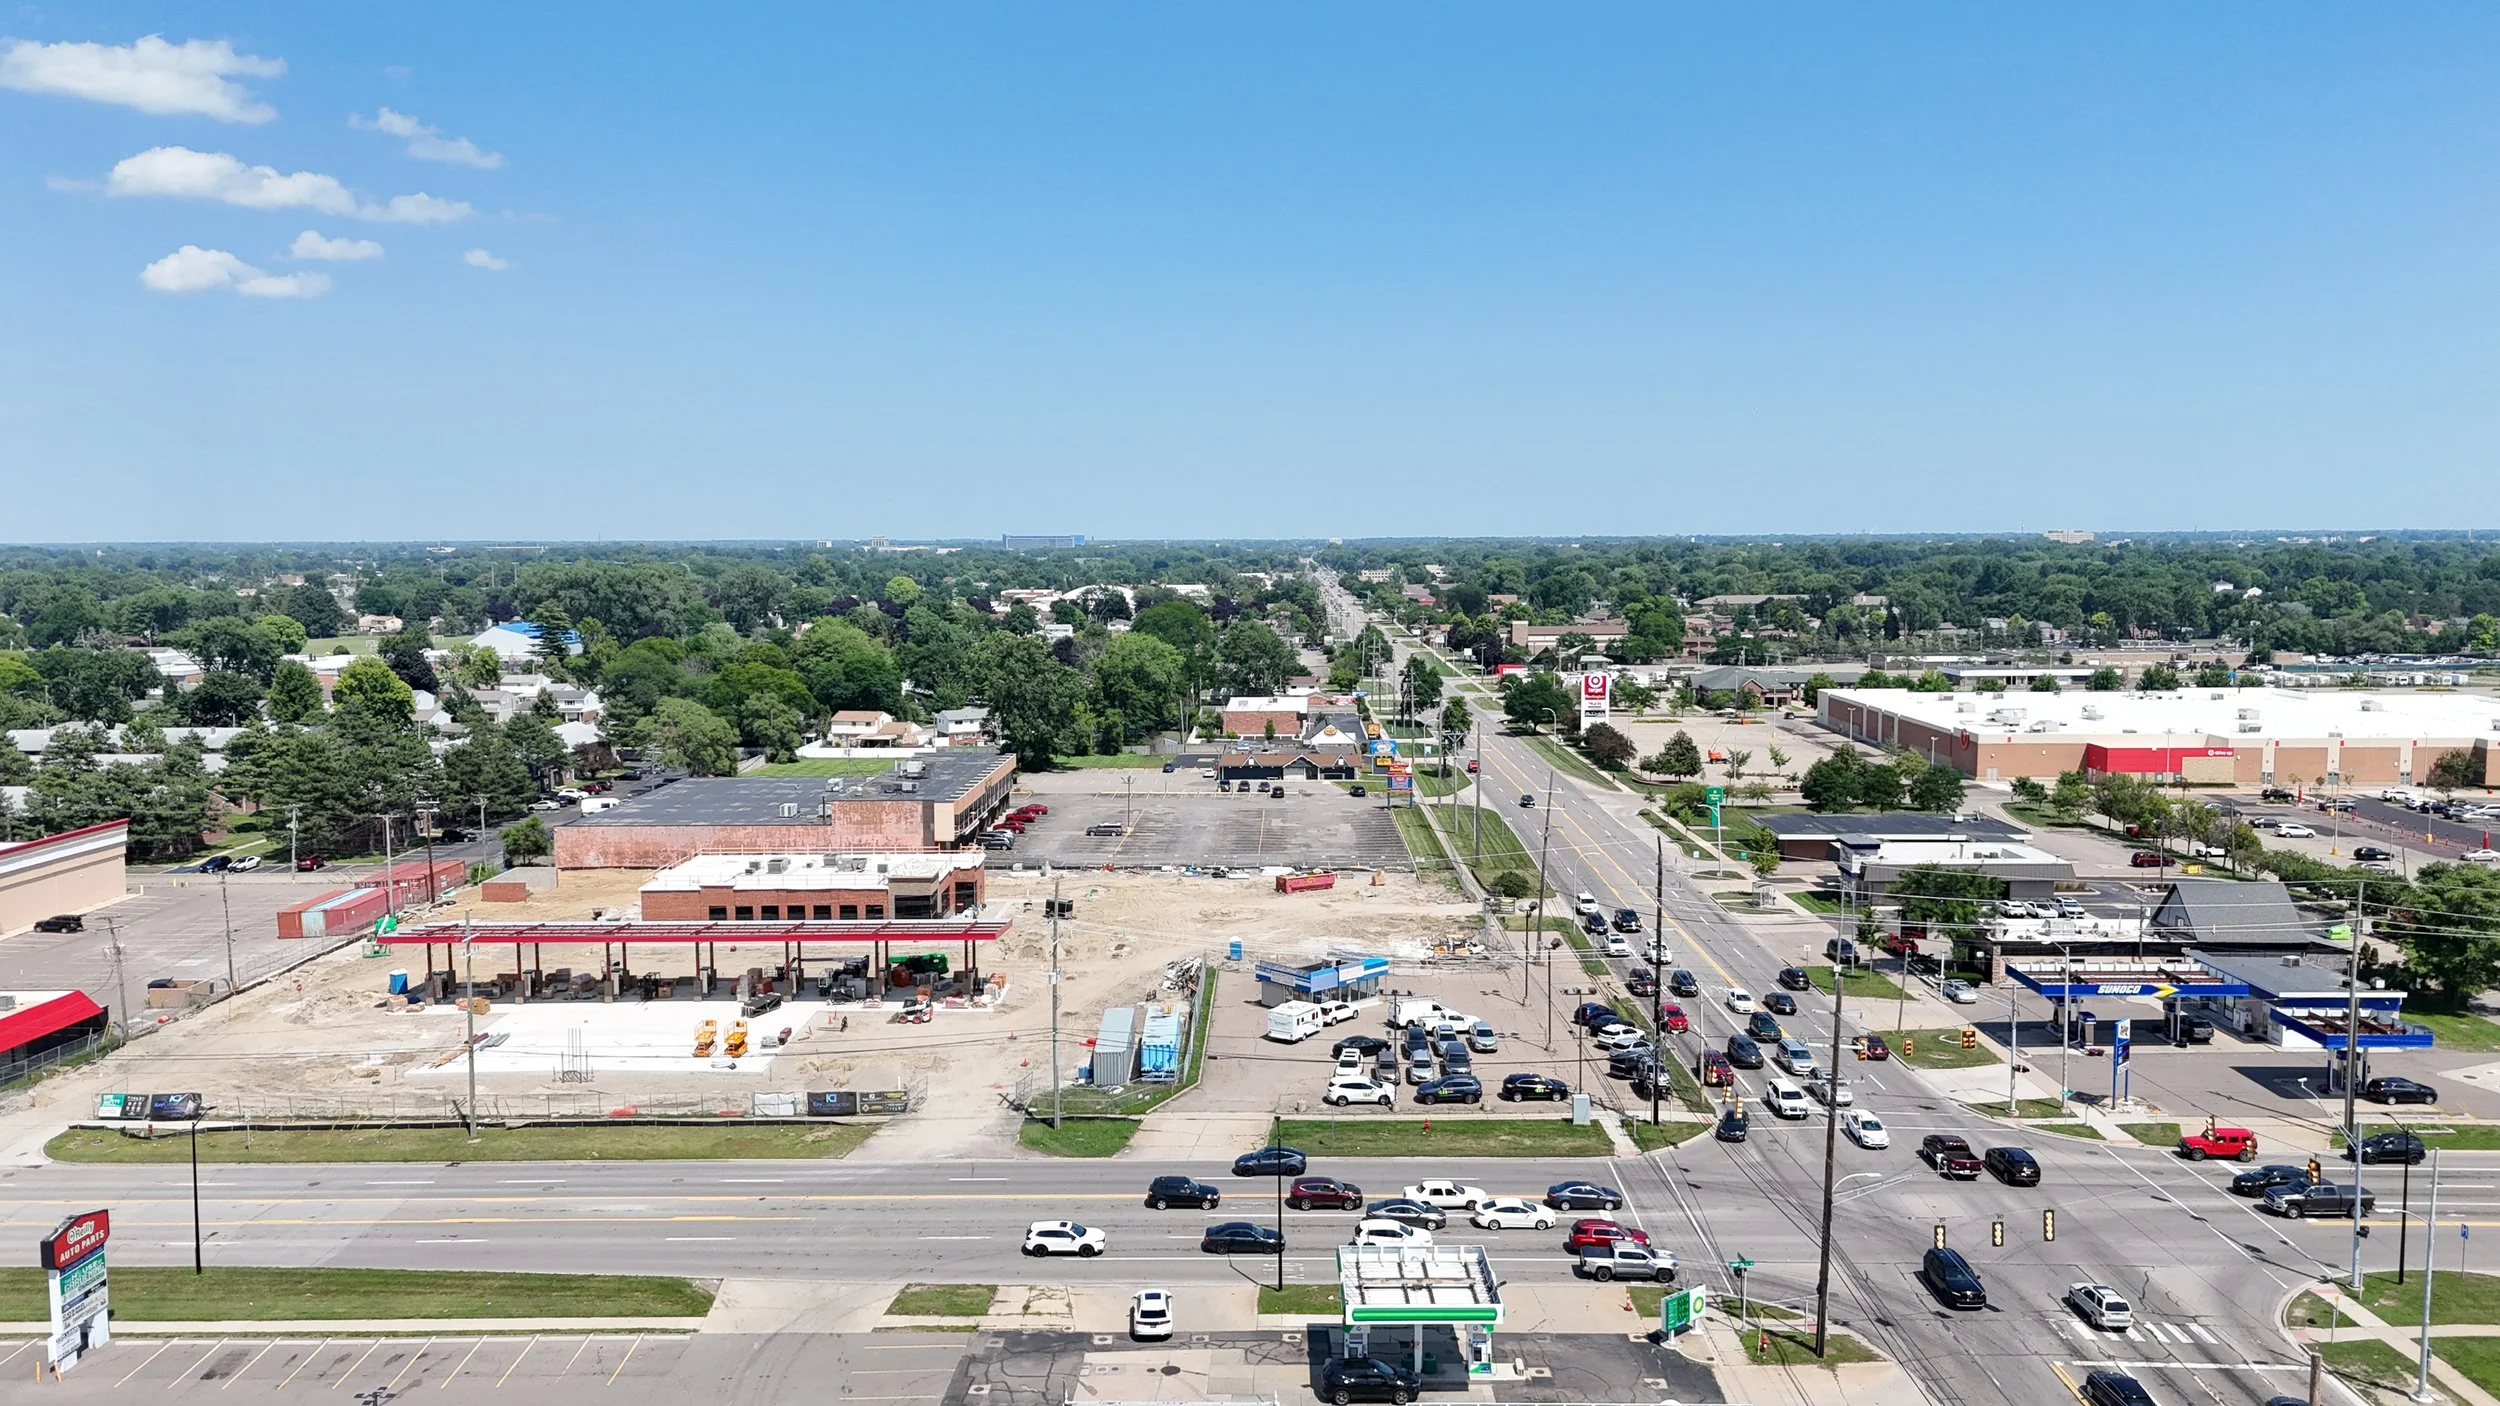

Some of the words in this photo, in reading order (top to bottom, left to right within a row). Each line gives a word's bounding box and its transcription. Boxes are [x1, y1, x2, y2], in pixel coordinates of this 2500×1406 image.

[2097, 985, 2142, 994] SUNOCO
[67, 1221, 95, 1244] O'Reilly
[60, 1245, 80, 1263] AUTO
[81, 1230, 105, 1250] PARTS
